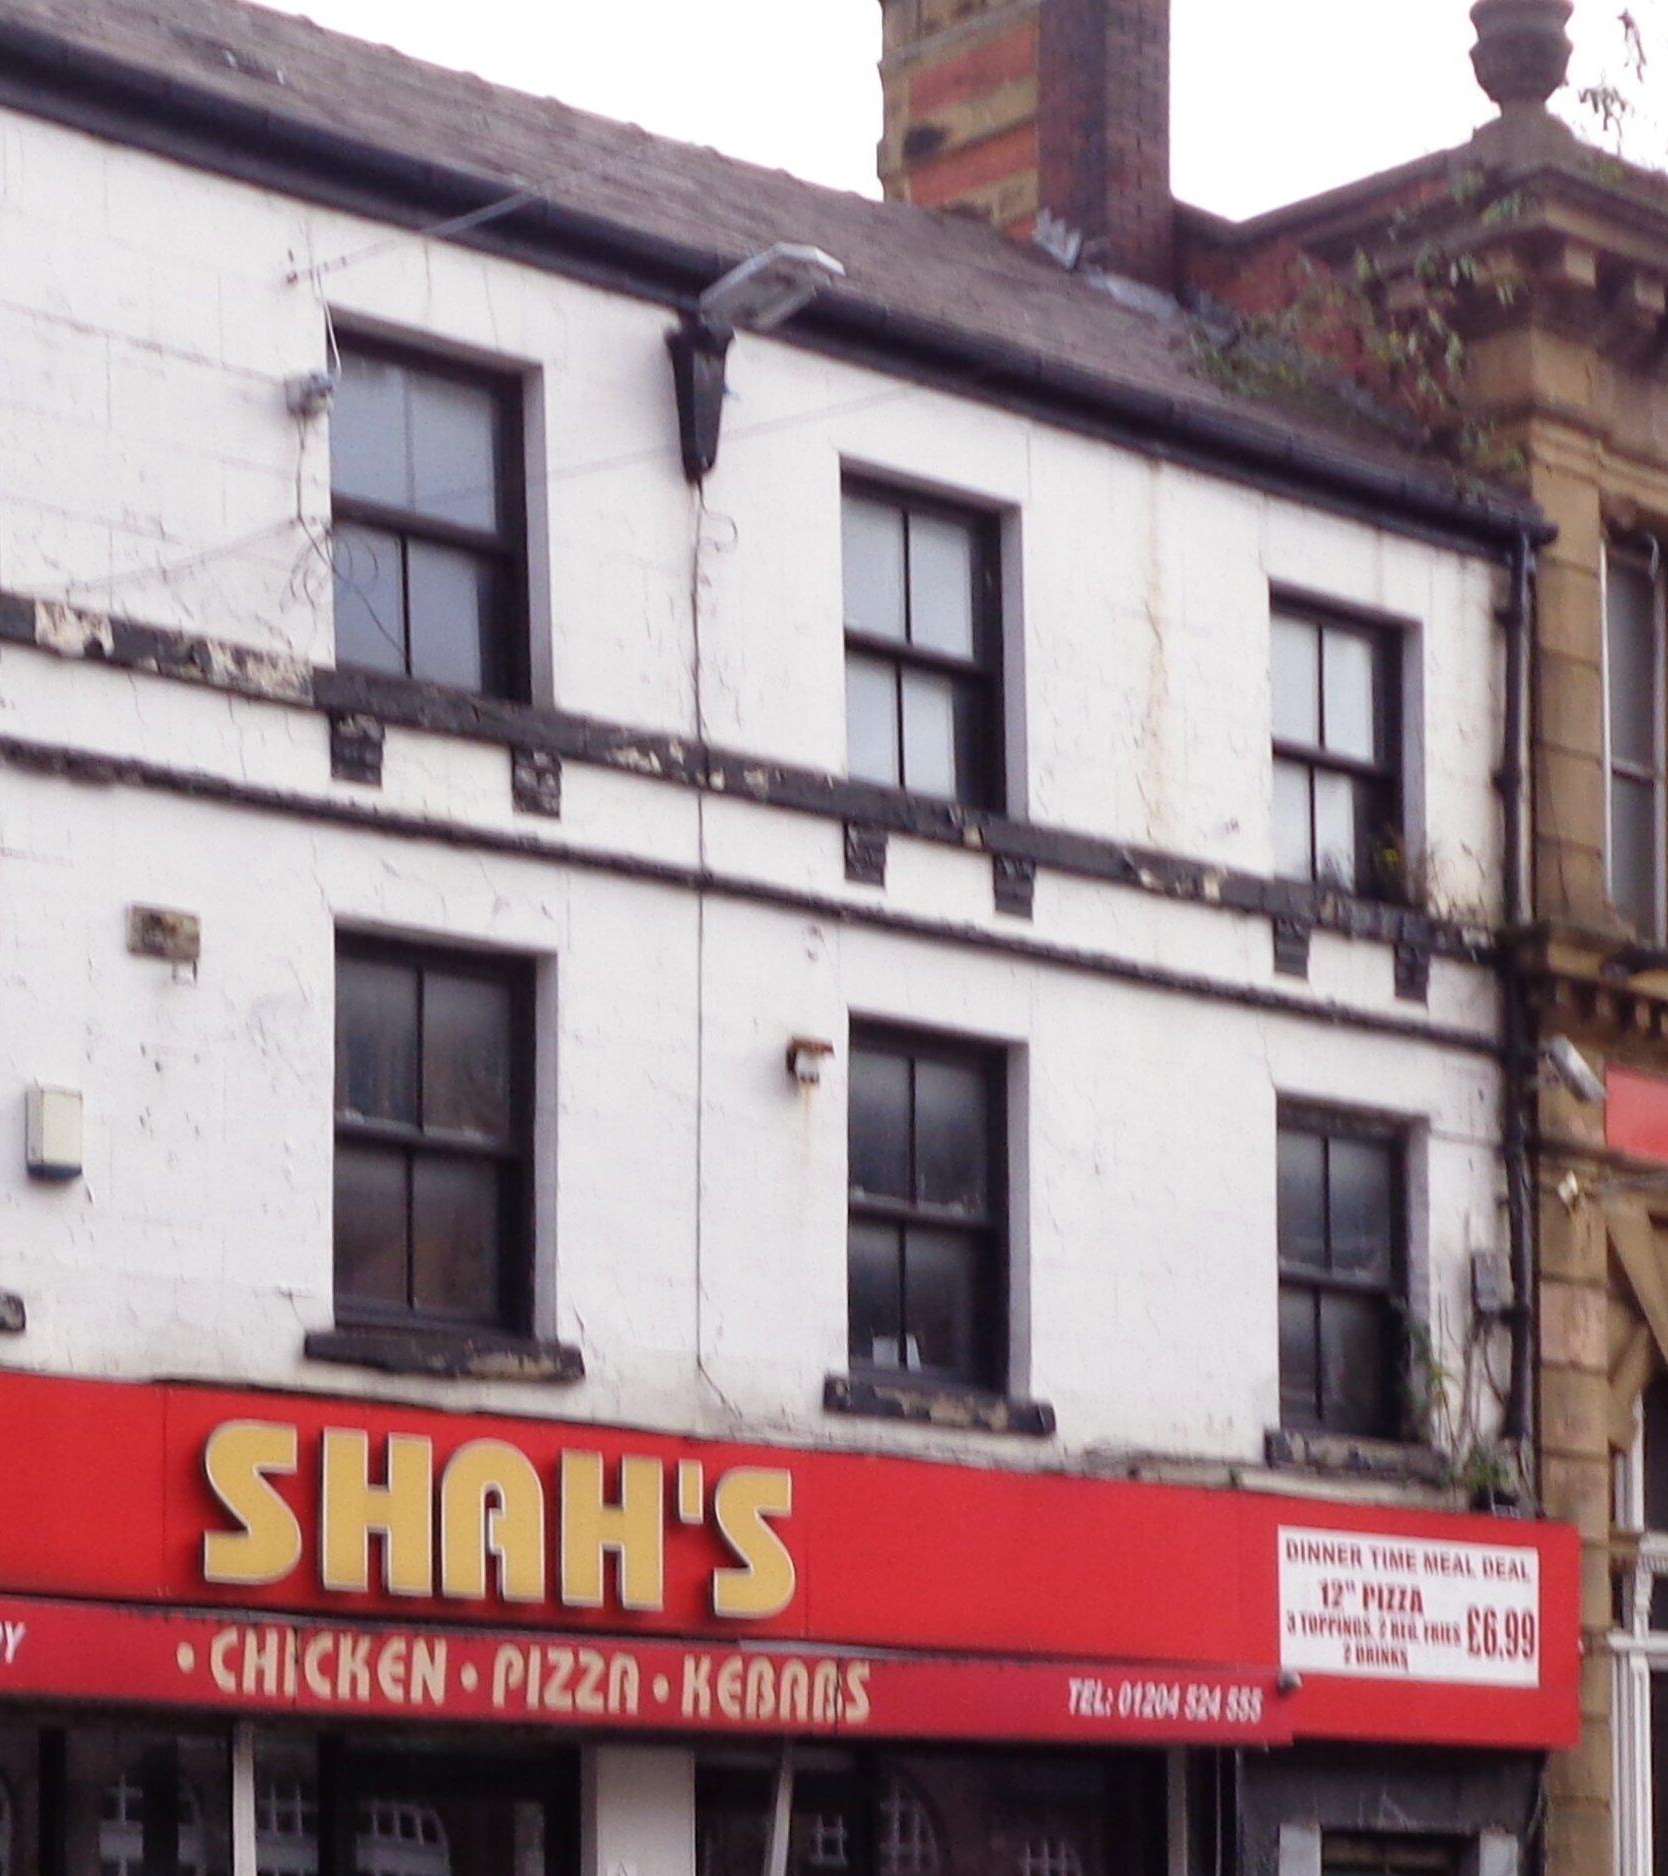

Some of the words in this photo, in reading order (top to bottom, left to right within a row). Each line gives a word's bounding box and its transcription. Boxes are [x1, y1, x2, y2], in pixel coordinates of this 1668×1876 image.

[202, 1418, 797, 1620] SHAH'S
[1285, 1538, 1363, 1571] DINNER
[1370, 1546, 1419, 1575] TIME
[1423, 1550, 1476, 1579] MEAL
[1482, 1556, 1533, 1584] DEAL
[1319, 1577, 1356, 1610] 12"
[1361, 1582, 1425, 1616] PIZZA
[1423, 1618, 1462, 1649] FRIES
[1466, 1604, 1535, 1662] £6.99
[209, 1626, 447, 1705] CHICKEN
[492, 1644, 640, 1715] PIZZA
[680, 1654, 873, 1724] KEBABS
[1355, 1644, 1410, 1673] DRINKS
[1067, 1677, 1114, 1718] TEL:
[1118, 1681, 1180, 1721] 01204
